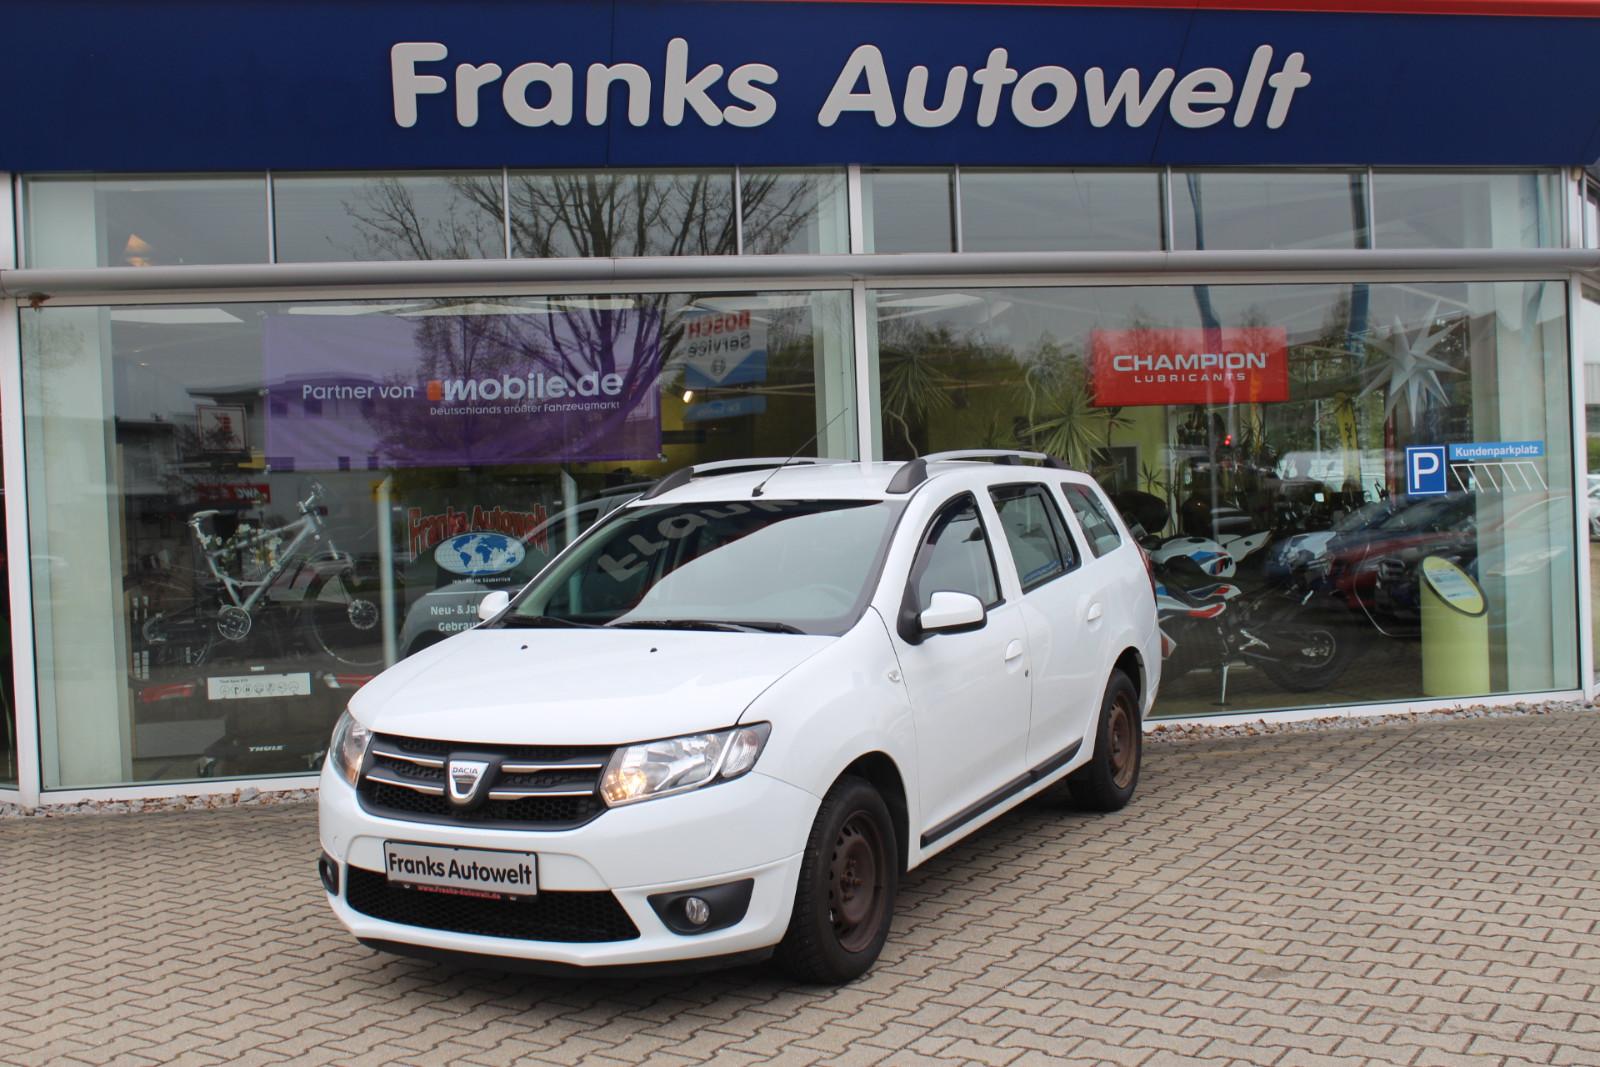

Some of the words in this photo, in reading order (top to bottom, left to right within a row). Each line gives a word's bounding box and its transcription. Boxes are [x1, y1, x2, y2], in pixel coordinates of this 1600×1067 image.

[390, 37, 779, 128] Franks
[817, 44, 1312, 129] Autowelt
[1113, 352, 1266, 372] CHAMPION
[302, 384, 374, 400] Partner
[379, 385, 415, 399] von
[443, 371, 624, 401] mobile.de
[1134, 372, 1246, 383] LUBRICANTS
[430, 404, 501, 416] Deutschlands
[543, 400, 621, 413] Fahrzeugmarkt
[1455, 445, 1540, 457] Kundenparkplatz
[1413, 452, 1440, 489] P
[408, 506, 470, 563] Franks
[471, 503, 549, 556] Autowelt
[430, 606, 455, 615] Neu-
[456, 605, 464, 614] &
[452, 767, 478, 775] DACIA
[389, 853, 445, 877] Franks
[448, 859, 532, 885] Autowelt
